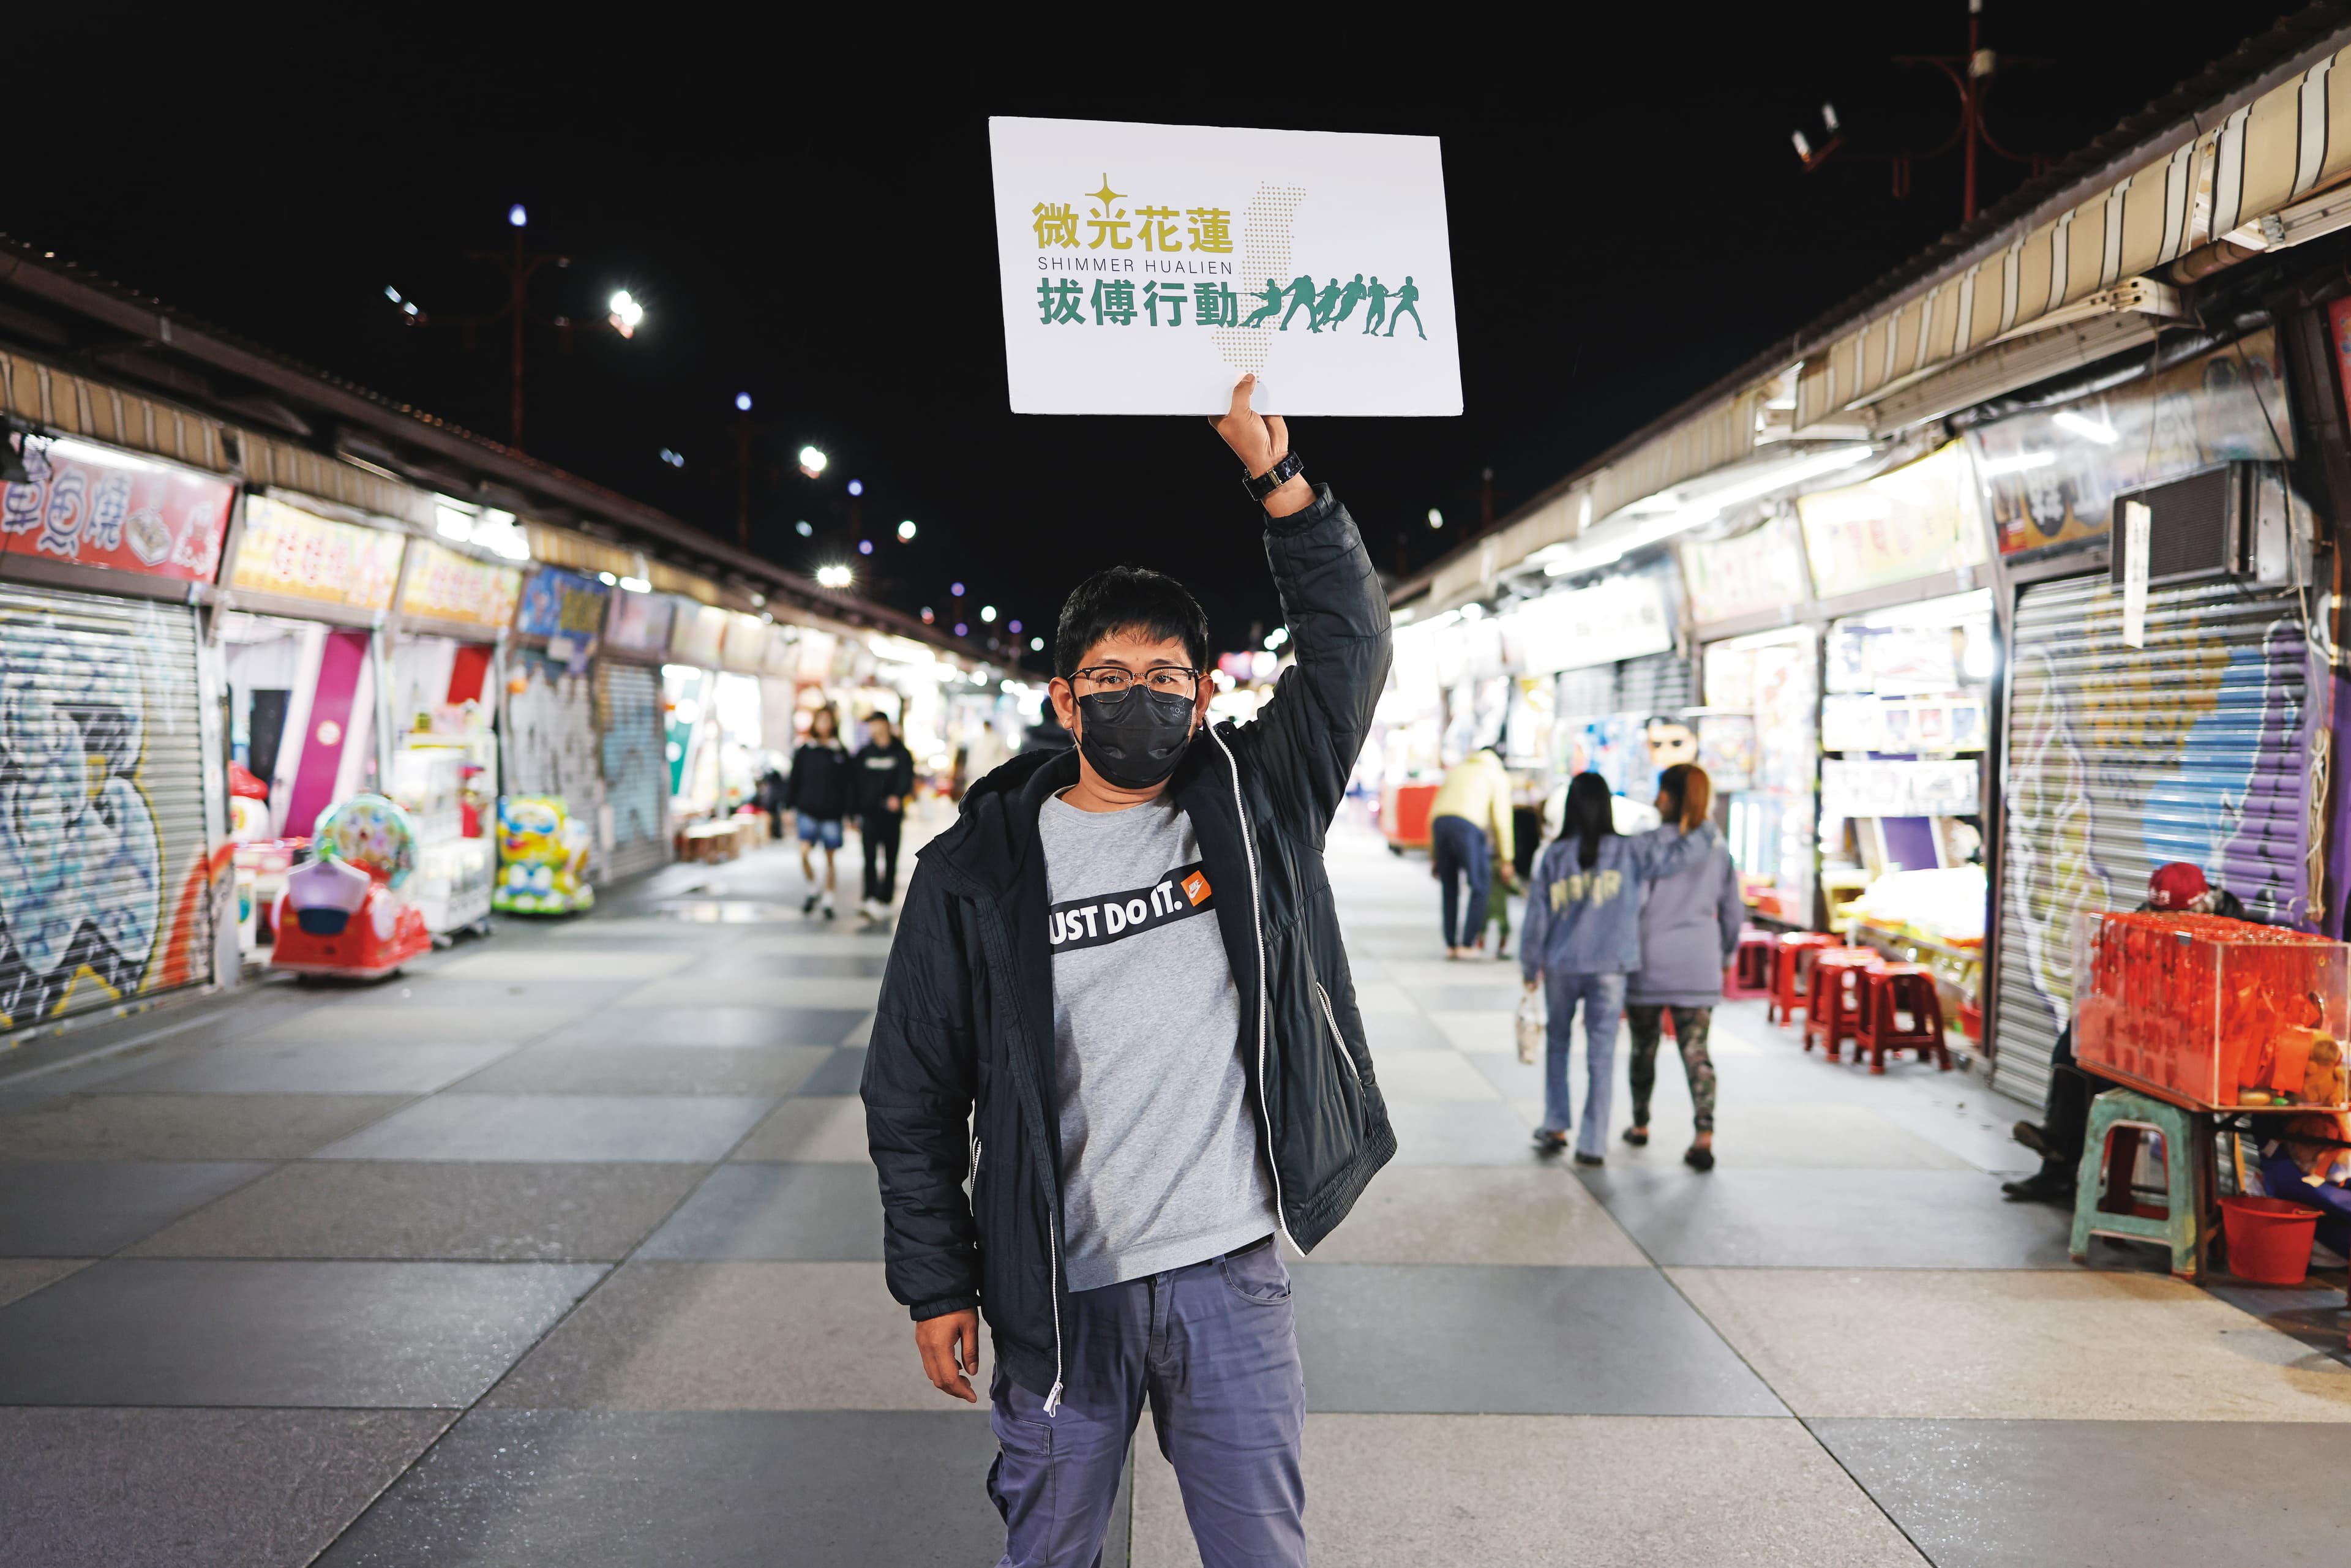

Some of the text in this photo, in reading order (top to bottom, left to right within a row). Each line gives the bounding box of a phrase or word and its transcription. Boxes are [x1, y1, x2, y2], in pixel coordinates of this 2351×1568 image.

[1032, 197, 1234, 253] 微光花蓮
[1038, 257, 1232, 275] SHIMMER HUALIEN
[1037, 277, 1238, 328] 拔傅行動
[1049, 880, 1183, 945] UST DO IT.
